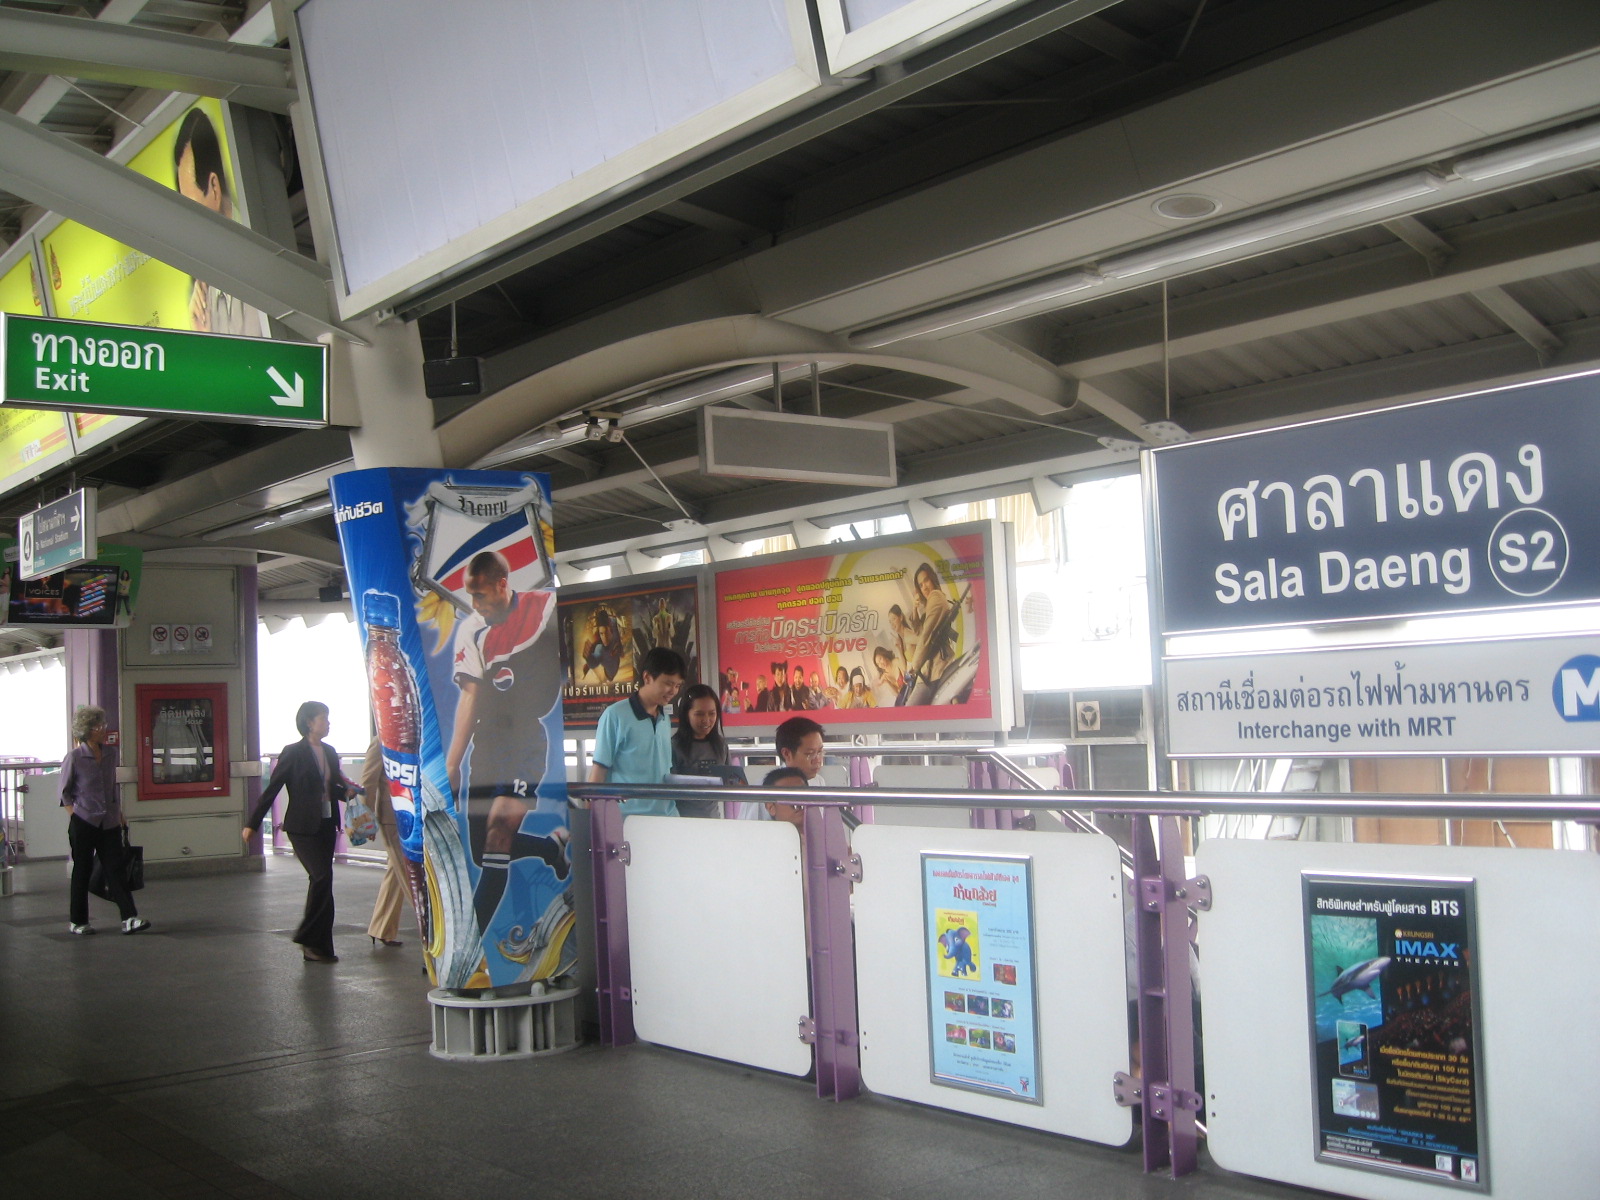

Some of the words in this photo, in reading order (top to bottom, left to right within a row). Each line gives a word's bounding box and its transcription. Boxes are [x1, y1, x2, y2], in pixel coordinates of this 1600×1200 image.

[32, 333, 165, 371] ทางออก
[36, 367, 90, 392] Exit
[1217, 443, 1543, 541] ศาลาแดง
[1499, 530, 1556, 574] S2
[1215, 558, 1304, 604] Sala
[1319, 547, 1471, 596] Daeng
[1177, 661, 1529, 713] สถานีเชื่อมต่อรถไฟฟ้ามหานคร
[1238, 718, 1351, 743] Interchange
[1357, 715, 1401, 738] with
[1407, 716, 1457, 737] MRT
[513, 778, 529, 797] 12
[1431, 900, 1459, 916] BTS
[1395, 940, 1458, 959] IMAX
[1396, 957, 1459, 967] THEATRE
